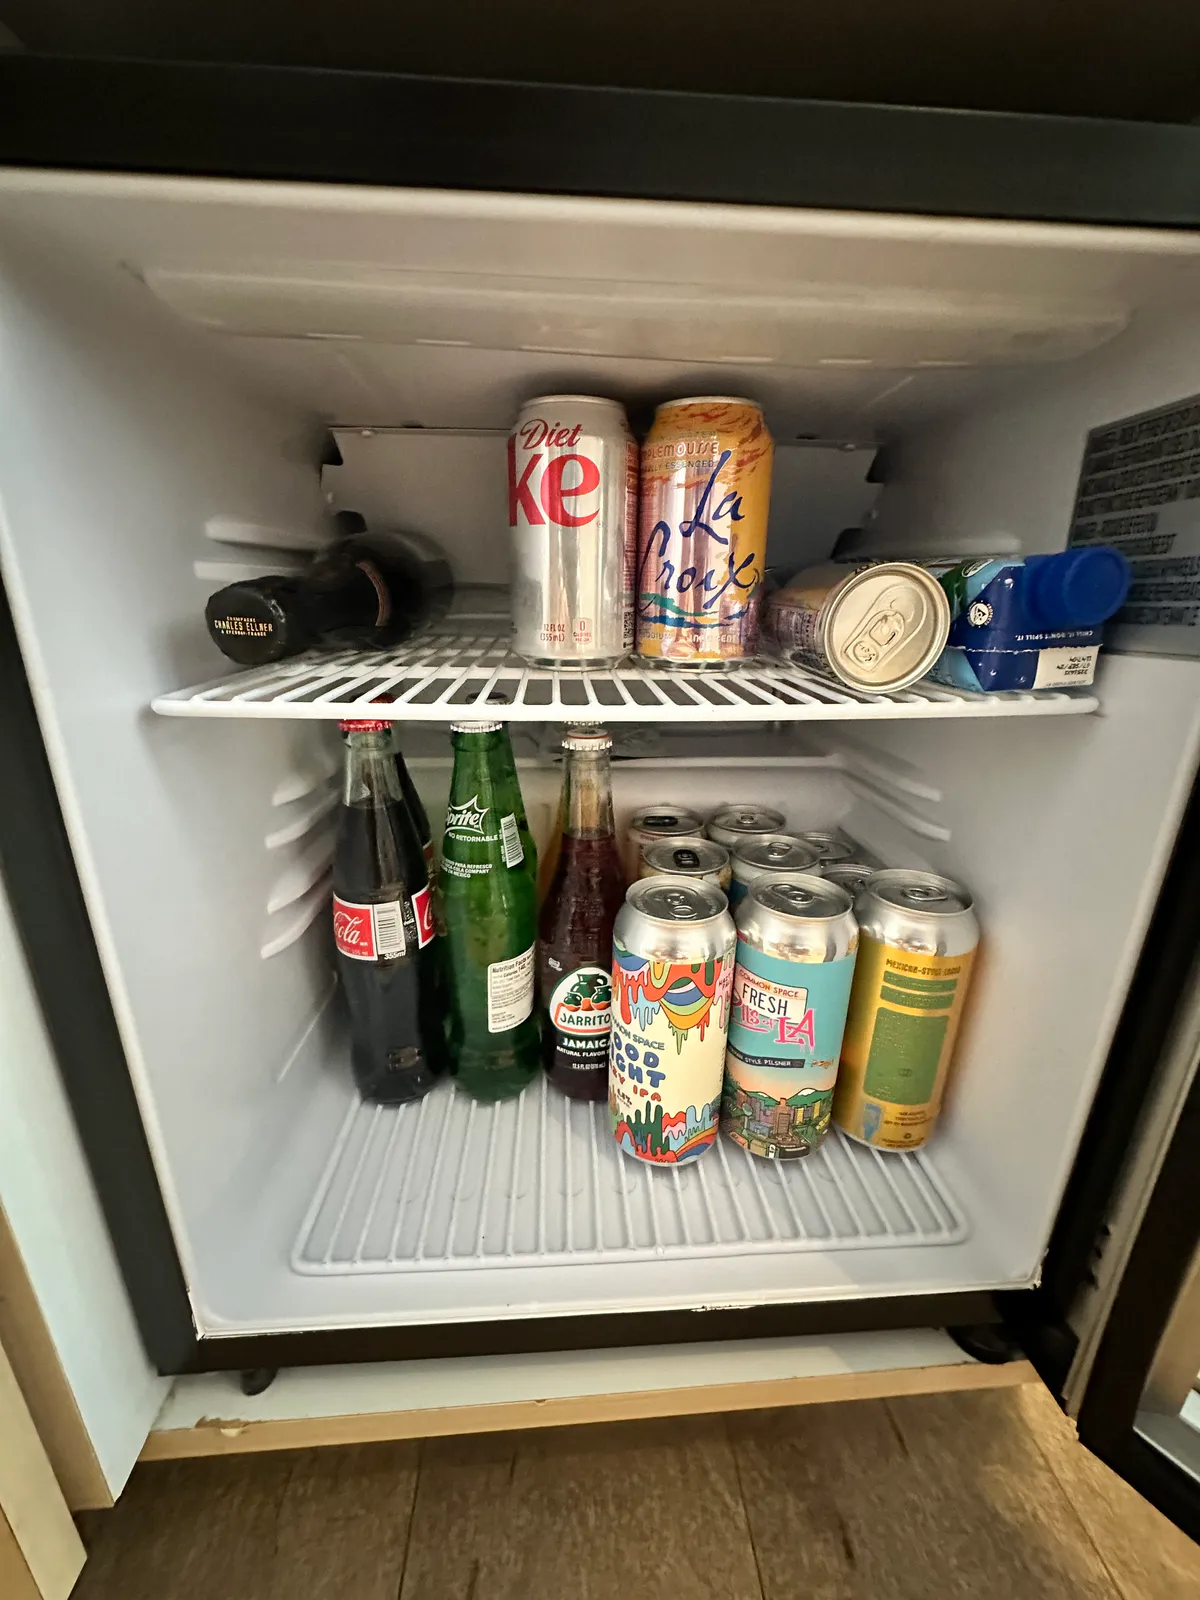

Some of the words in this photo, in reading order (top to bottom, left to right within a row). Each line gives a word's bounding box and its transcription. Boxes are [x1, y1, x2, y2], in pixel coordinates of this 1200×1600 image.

[520, 419, 583, 450] Diet
[679, 450, 745, 545] La
[636, 521, 760, 612] Croix
[214, 620, 243, 631] CHARLES
[456, 834, 498, 842] RETORNABLE
[739, 969, 771, 991] COMMON
[773, 987, 799, 998] SPACE
[742, 983, 789, 1017] FRESH
[556, 1045, 581, 1057] NATURAL
[632, 1034, 665, 1050] SPACE
[764, 1059, 791, 1067] PILSNER
